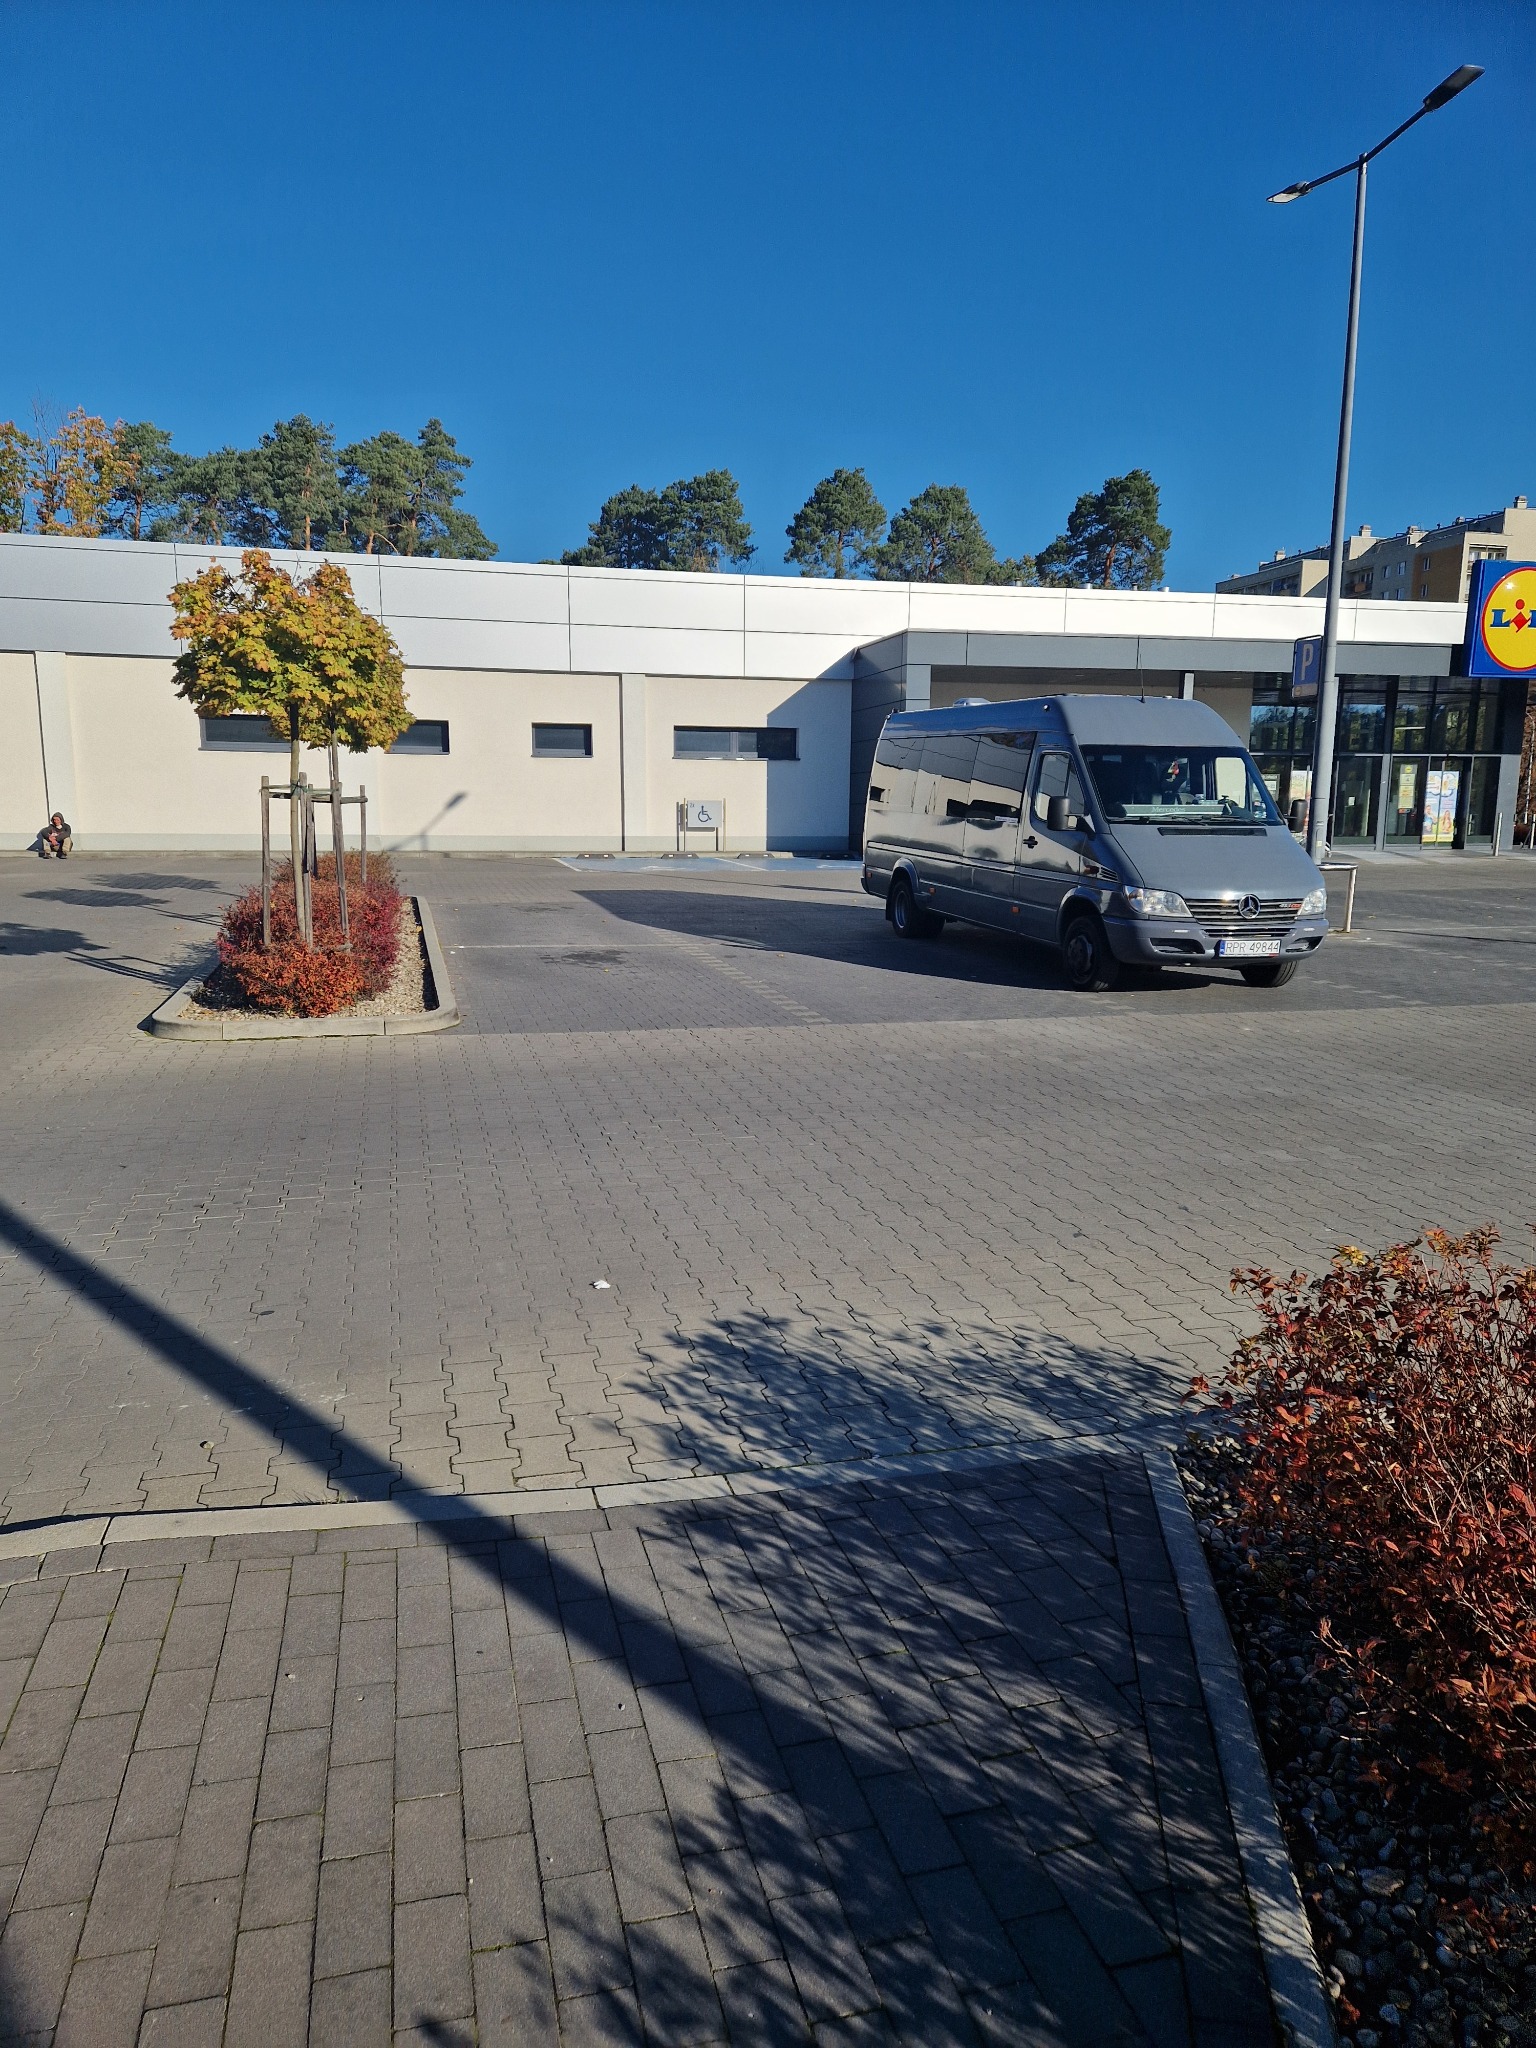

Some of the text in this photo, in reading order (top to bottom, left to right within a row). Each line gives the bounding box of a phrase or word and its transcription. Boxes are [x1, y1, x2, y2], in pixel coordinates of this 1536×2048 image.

[1301, 643, 1314, 681] P
[1225, 941, 1280, 953] RPR 49844
